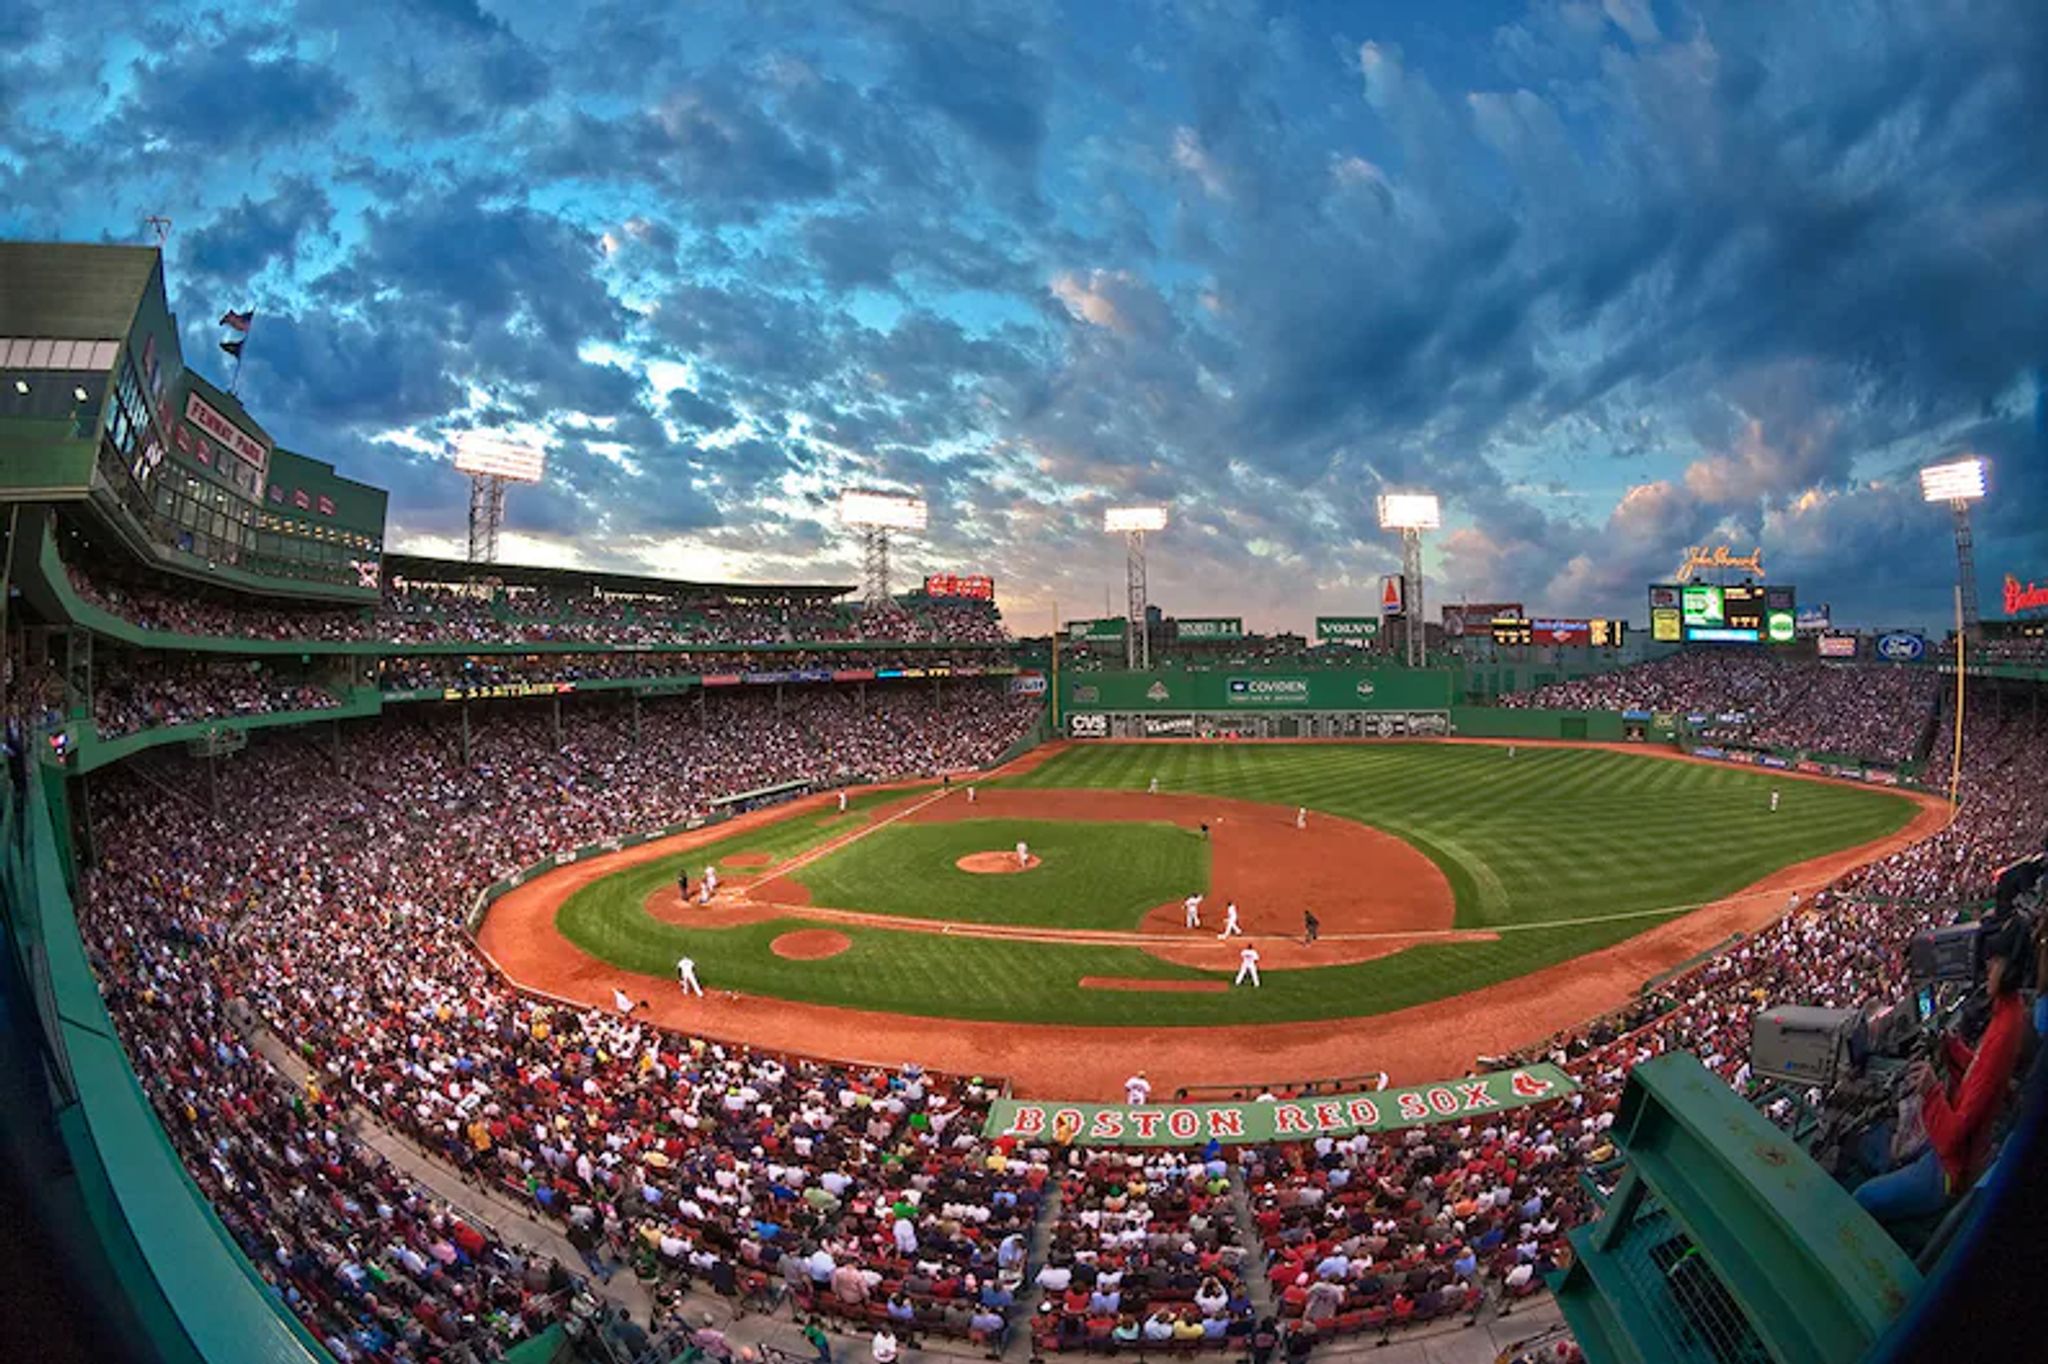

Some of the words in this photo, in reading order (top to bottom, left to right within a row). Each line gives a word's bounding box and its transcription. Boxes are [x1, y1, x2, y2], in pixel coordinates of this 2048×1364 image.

[190, 401, 233, 441] FENWAY
[235, 436, 261, 462] PARK
[1321, 624, 1376, 633] VOLVO
[1248, 681, 1306, 692] COVIDIEN
[1072, 715, 1106, 729] CVS
[1013, 1107, 1244, 1139] BOSTON
[1274, 1097, 1379, 1133] RED
[1398, 1080, 1499, 1120] SOX
